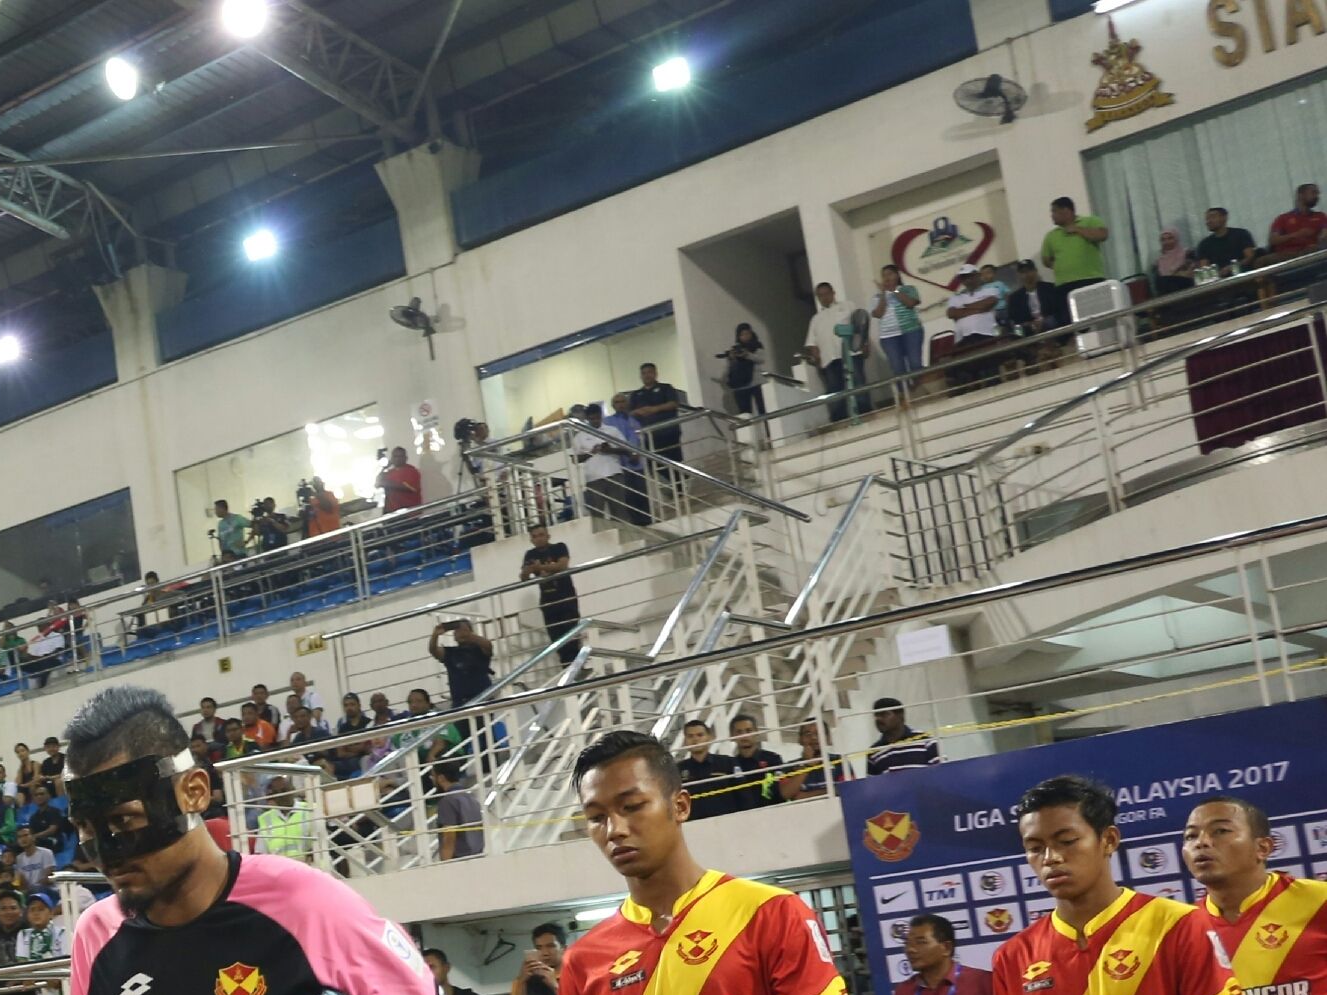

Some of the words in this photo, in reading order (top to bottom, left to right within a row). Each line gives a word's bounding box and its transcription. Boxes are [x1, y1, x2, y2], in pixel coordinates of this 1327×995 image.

[954, 808, 1005, 832] LIGA
[1113, 773, 1224, 806] ALAYSIA
[1228, 761, 1290, 789] 2017
[1149, 807, 1167, 819] FA
[925, 888, 956, 901] TM
